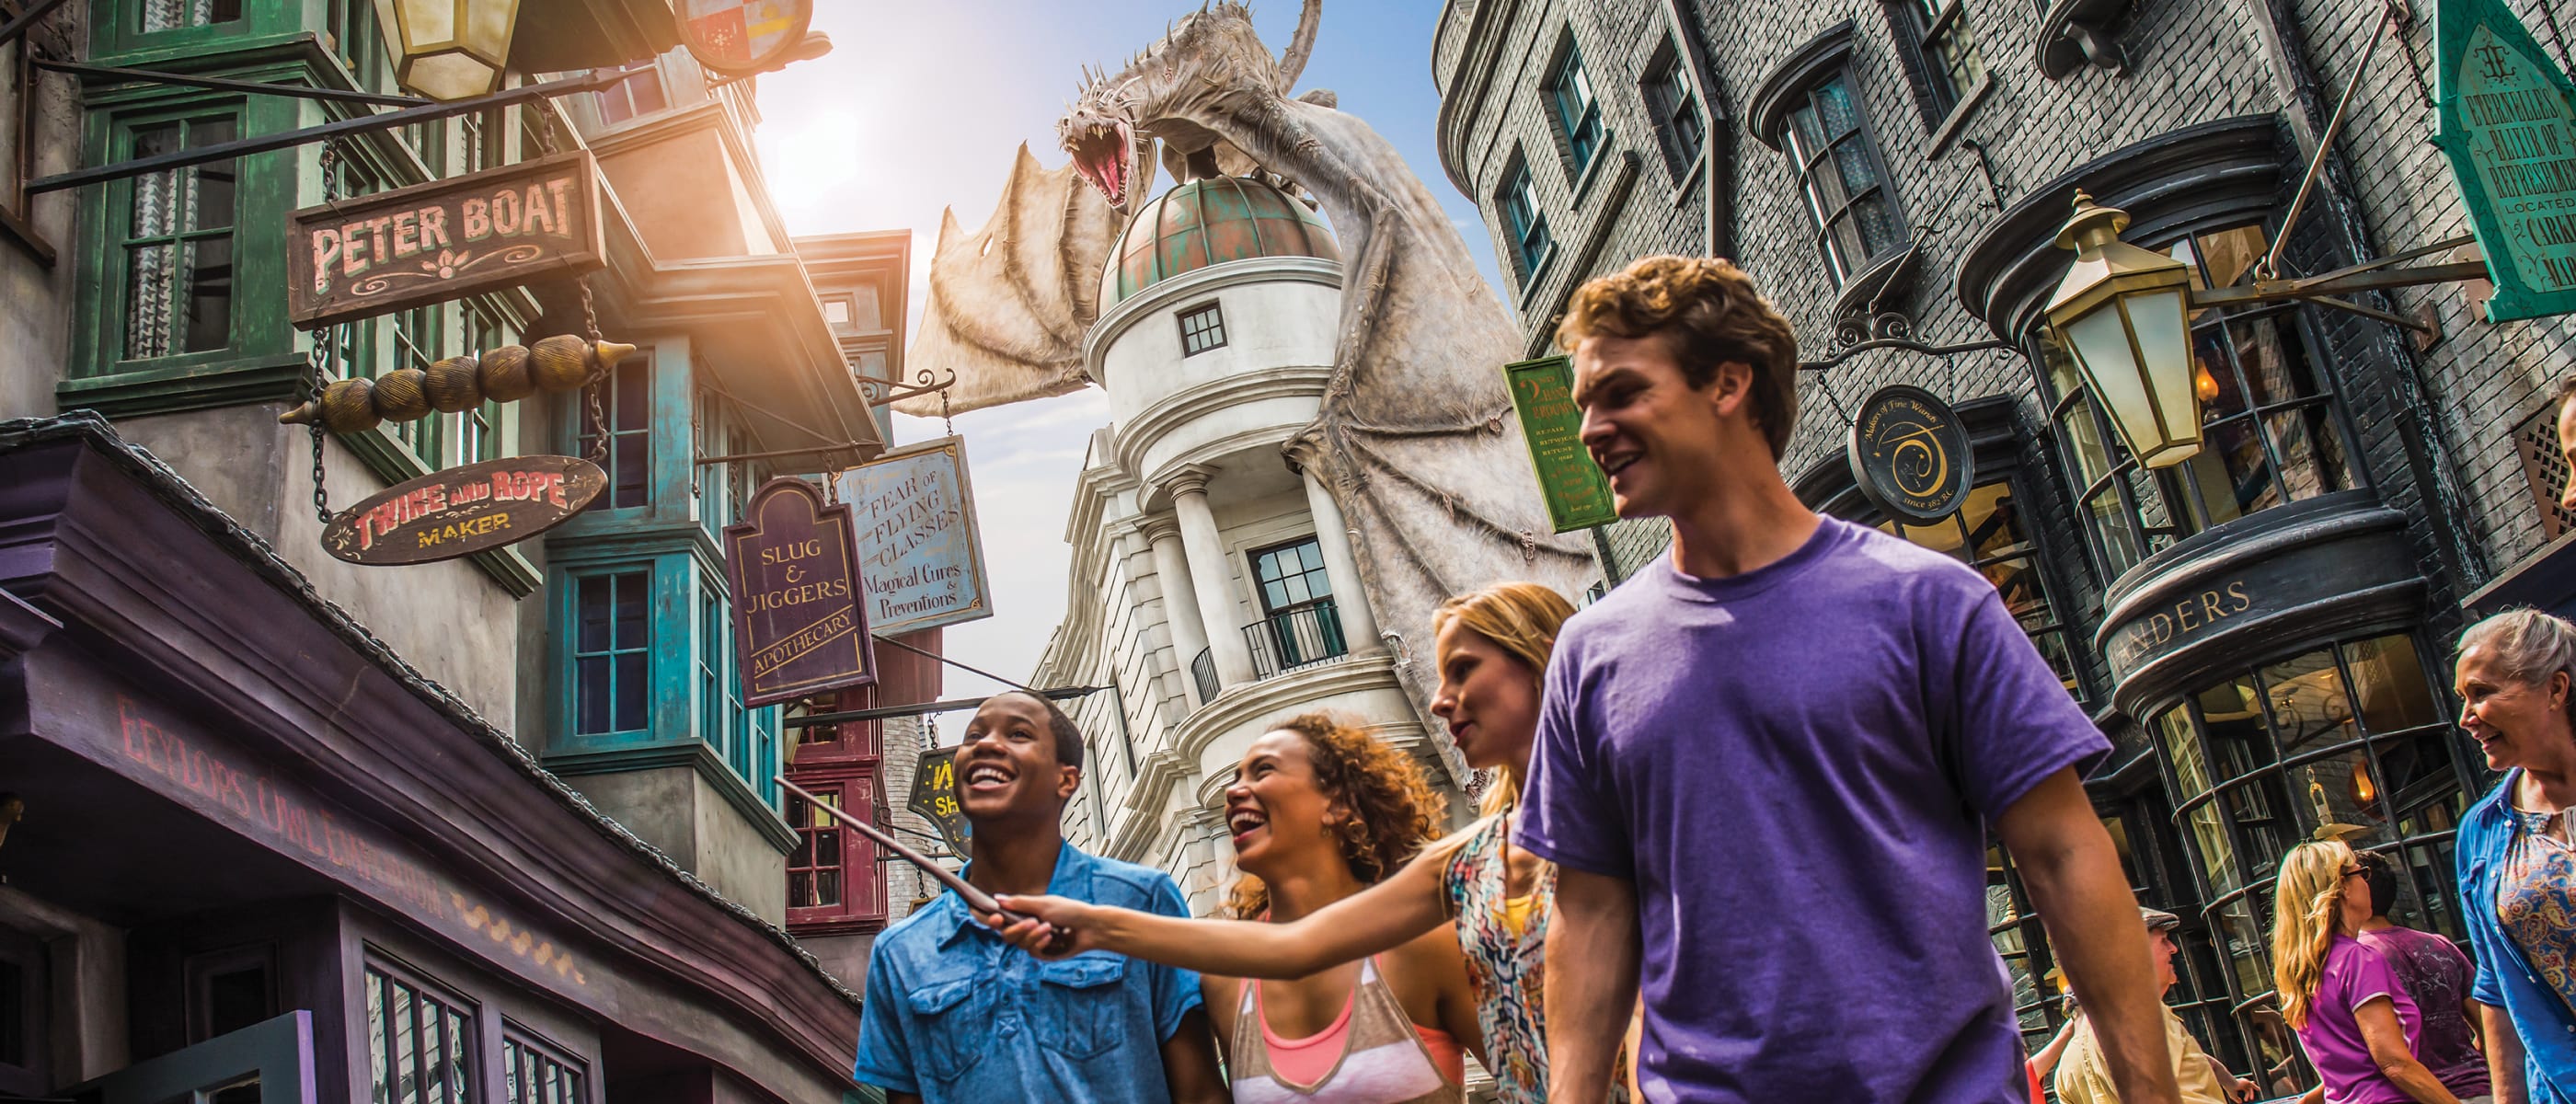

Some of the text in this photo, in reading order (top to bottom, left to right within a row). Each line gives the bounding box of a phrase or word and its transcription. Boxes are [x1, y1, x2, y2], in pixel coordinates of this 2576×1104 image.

[2489, 123, 2562, 162] ELIXIR OF
[2505, 198, 2576, 214] LOCATED
[312, 176, 575, 295] PETER BOAT
[1888, 399, 1907, 410] Fine
[1910, 399, 1938, 423] Wands
[354, 469, 569, 552] TWINE AND ROPE
[871, 477, 918, 520] FEAR
[923, 470, 937, 488] OF
[418, 512, 512, 549] MAKER
[875, 489, 940, 545] FLYING
[880, 502, 960, 568] CLASSES
[762, 539, 822, 567] SLUG
[785, 565, 806, 583] &
[864, 563, 961, 597] Magical Cures
[947, 581, 957, 591] &
[745, 578, 847, 615] JIGGERS
[880, 592, 957, 619] Preventions
[753, 609, 853, 675] APOTHECARY
[117, 693, 250, 819] EEYLOPS
[258, 776, 324, 857] OWL
